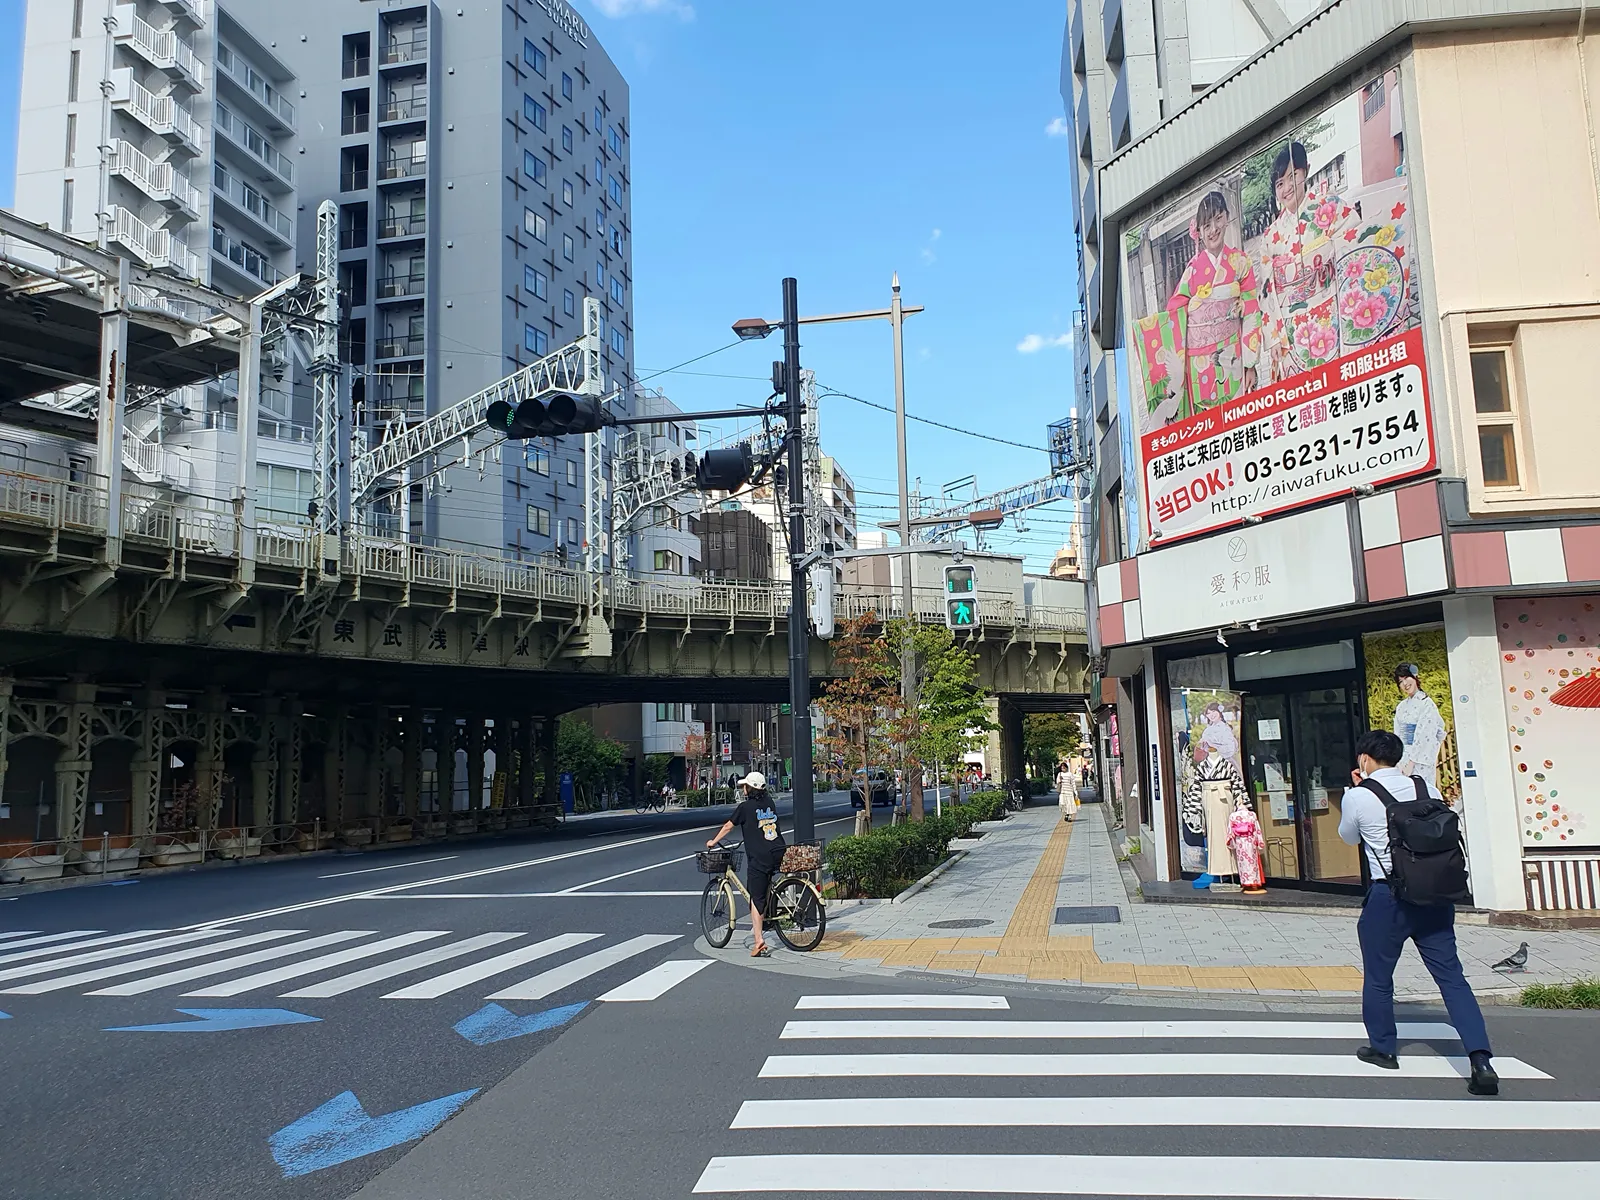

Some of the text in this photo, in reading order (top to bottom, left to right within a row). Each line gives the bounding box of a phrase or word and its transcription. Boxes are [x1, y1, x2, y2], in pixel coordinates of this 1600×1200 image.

[547, 7, 578, 42] SUITES
[1224, 397, 1274, 424] KIMONO
[1275, 372, 1328, 404] Rental
[1340, 341, 1408, 381] 和服出租
[1153, 372, 1413, 480] 私達はご来店の皆様に愛と感動を贈ります。
[1244, 410, 1419, 483] 03-6231-7554
[1154, 462, 1234, 523] 当日OK!
[1211, 438, 1424, 514] http://aiwafuku.com/
[1211, 564, 1271, 596] 愛和服
[1220, 594, 1264, 608] AIWAFUKU
